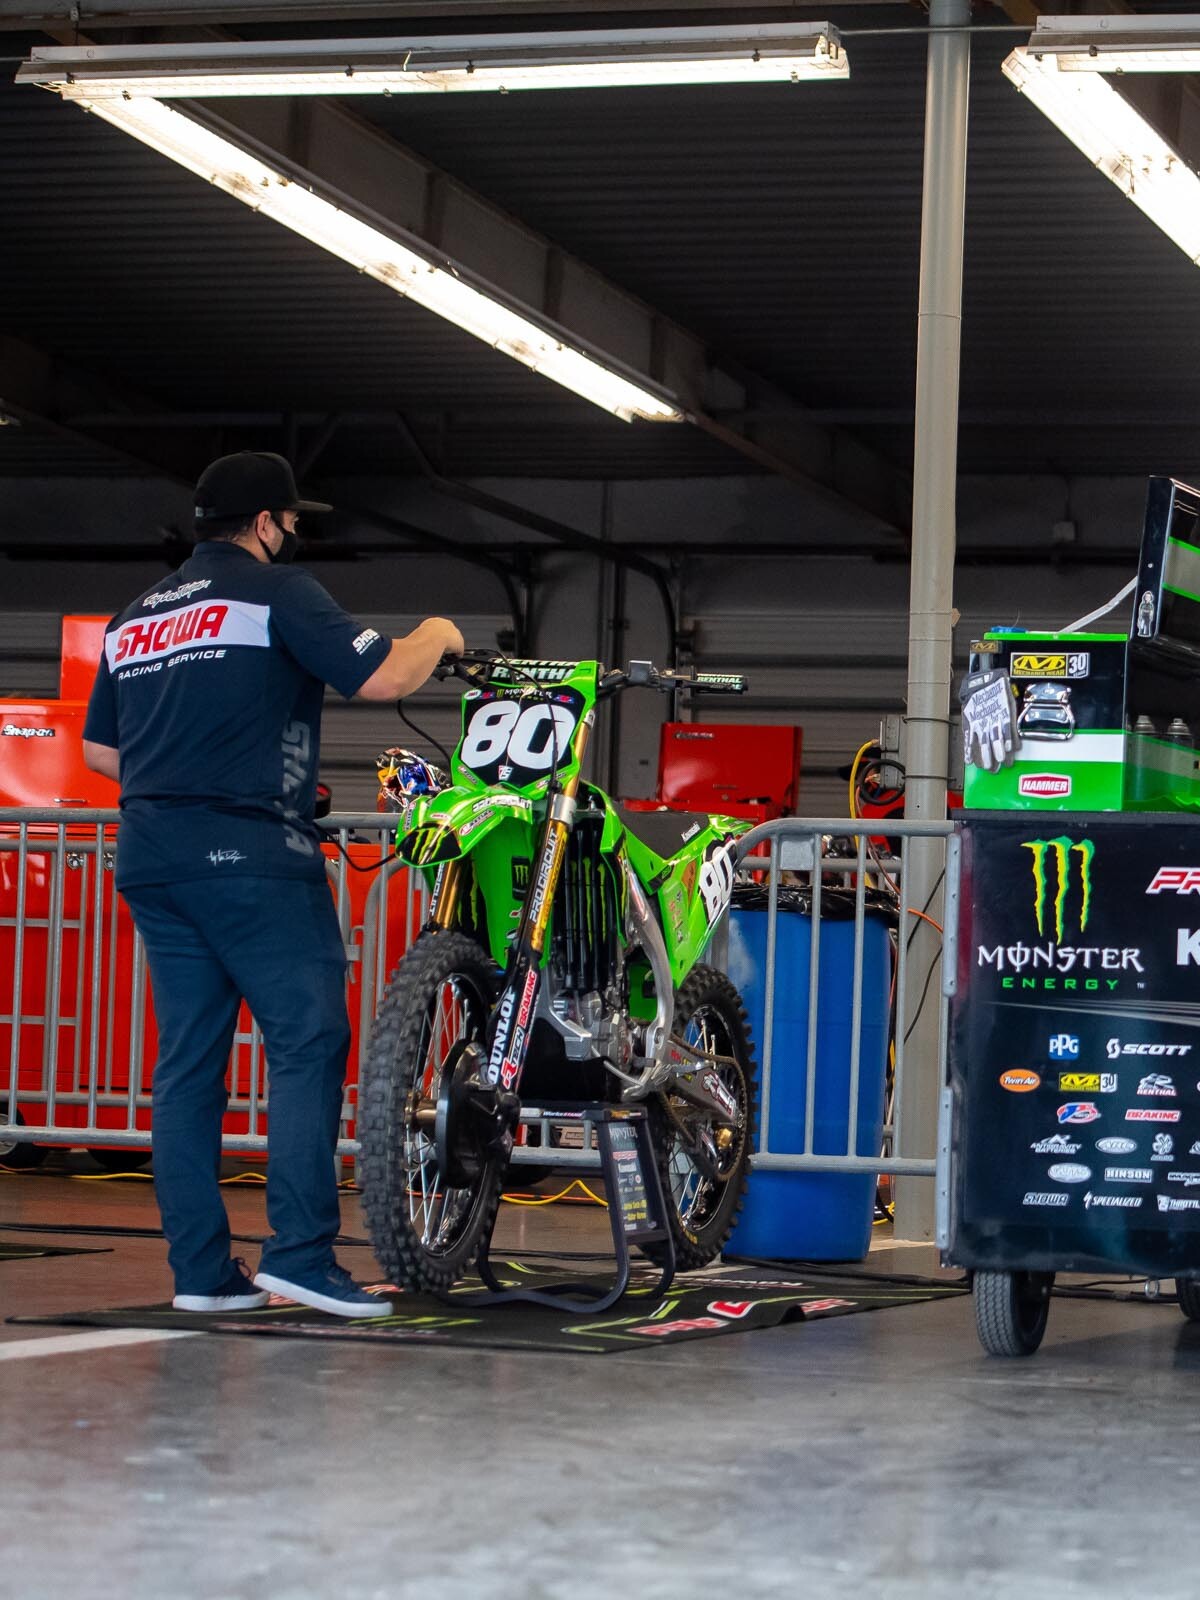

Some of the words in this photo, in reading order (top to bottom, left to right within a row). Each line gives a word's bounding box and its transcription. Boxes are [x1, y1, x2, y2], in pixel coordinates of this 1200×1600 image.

[114, 605, 229, 663] SHOWA
[118, 662, 163, 681] RACING
[167, 649, 227, 668] SERVICE
[1069, 653, 1086, 674] 30
[460, 700, 577, 770] 80
[1022, 779, 1068, 792] HAMMER
[529, 888, 545, 924] PRO
[537, 828, 559, 890] CIRCUIT
[699, 839, 737, 922] 80
[977, 942, 1145, 973] MONSTER
[1002, 977, 1119, 990] ENERGY
[519, 969, 538, 1029] BRAKING
[1049, 1033, 1080, 1057] PPG
[1120, 1043, 1192, 1056] SCOTT
[1136, 1088, 1177, 1097] RENTHAL
[1125, 1109, 1180, 1120] BRAKING
[1106, 1169, 1151, 1180] HINSON
[1091, 1194, 1143, 1207] SPECIALIZED
